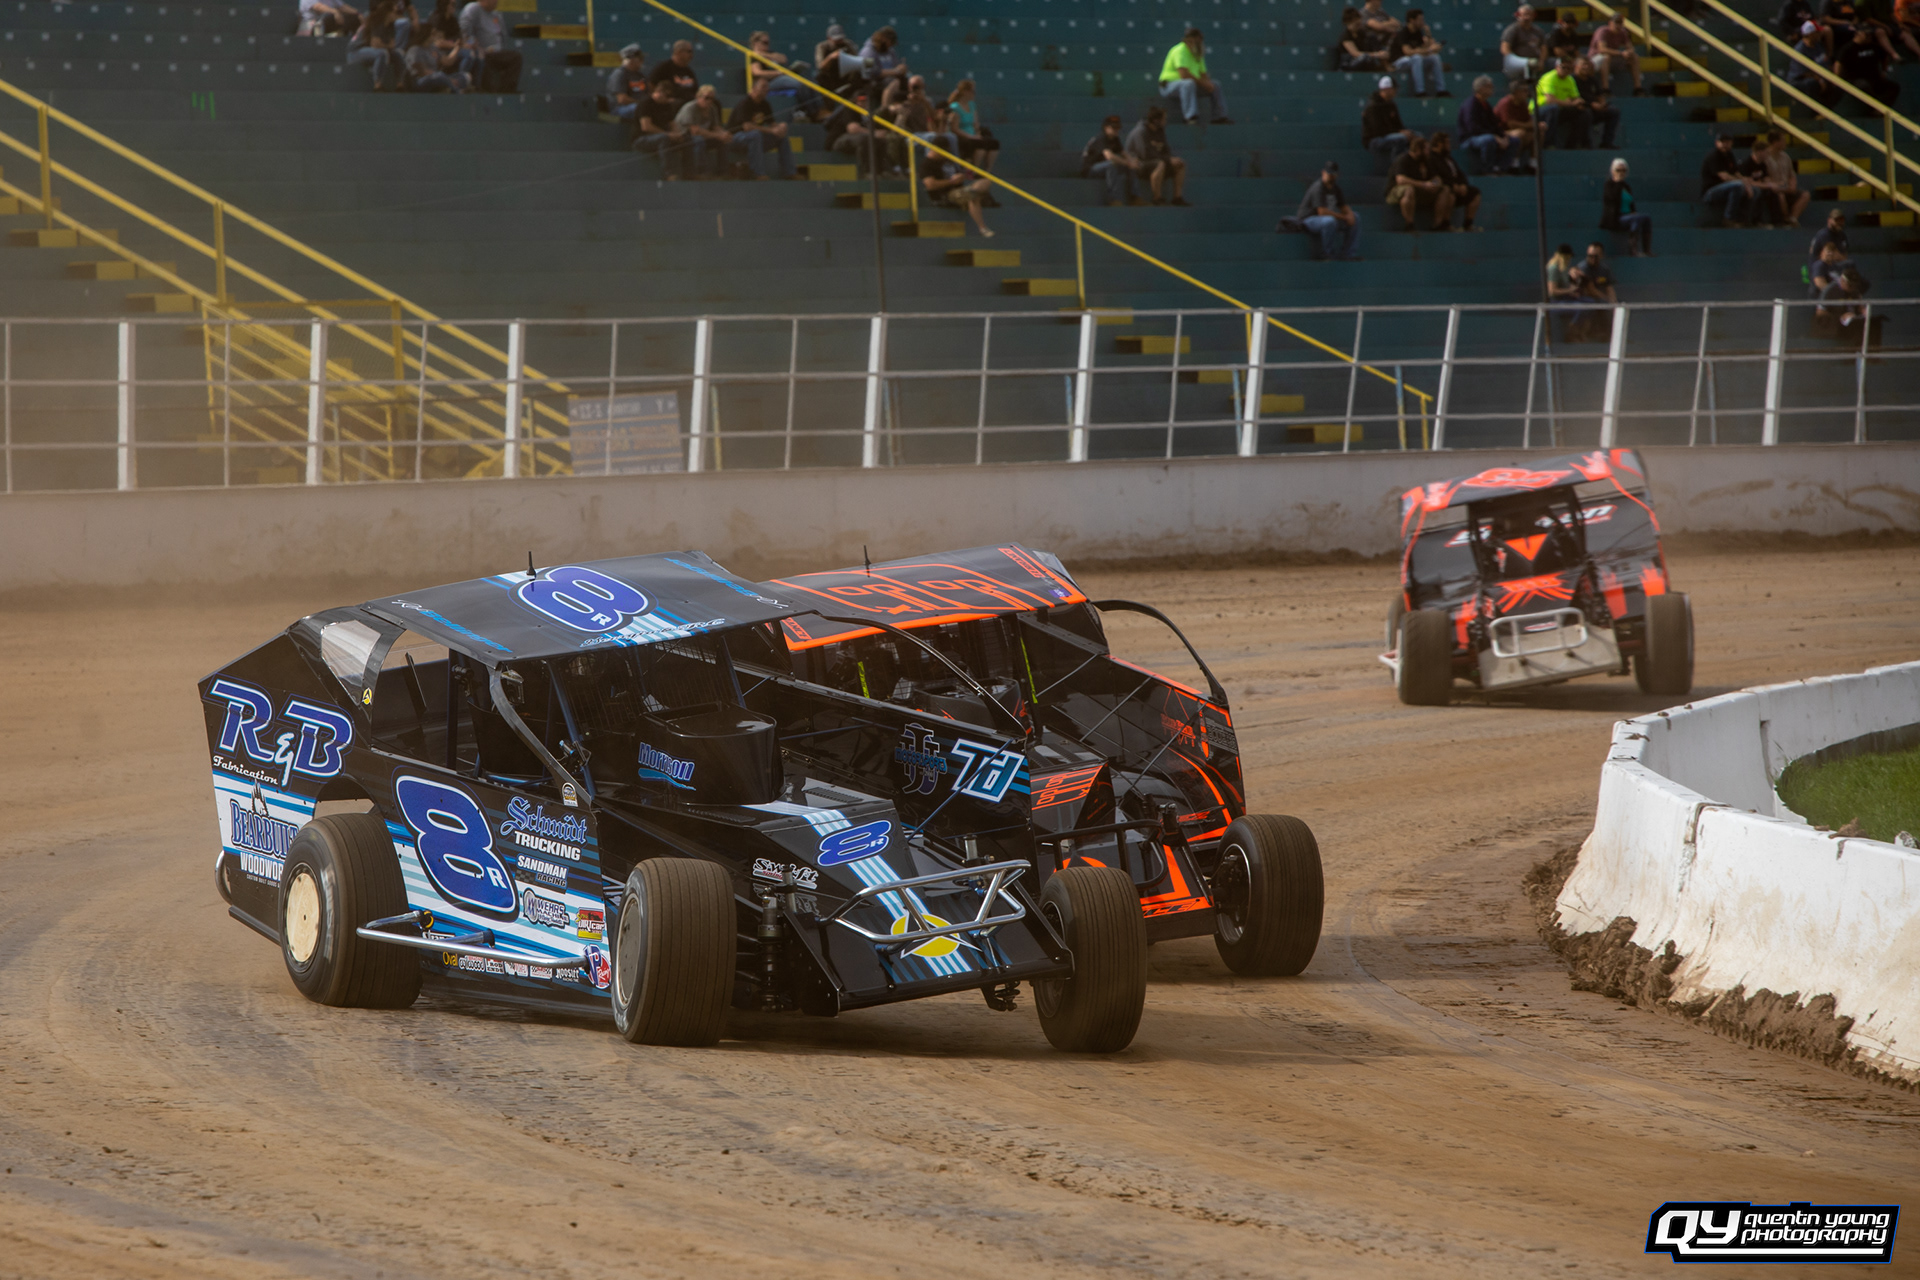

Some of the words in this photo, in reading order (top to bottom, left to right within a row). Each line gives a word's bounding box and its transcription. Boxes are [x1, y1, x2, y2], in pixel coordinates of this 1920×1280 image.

[213, 755, 279, 785] Fabrication
[500, 795, 588, 844] Schmidt
[514, 831, 582, 861] TRUCKING
[240, 851, 285, 882] WOODWOR
[517, 855, 568, 879] SANDMAN
[537, 872, 567, 888] RACING
[537, 899, 564, 914] WEHRS
